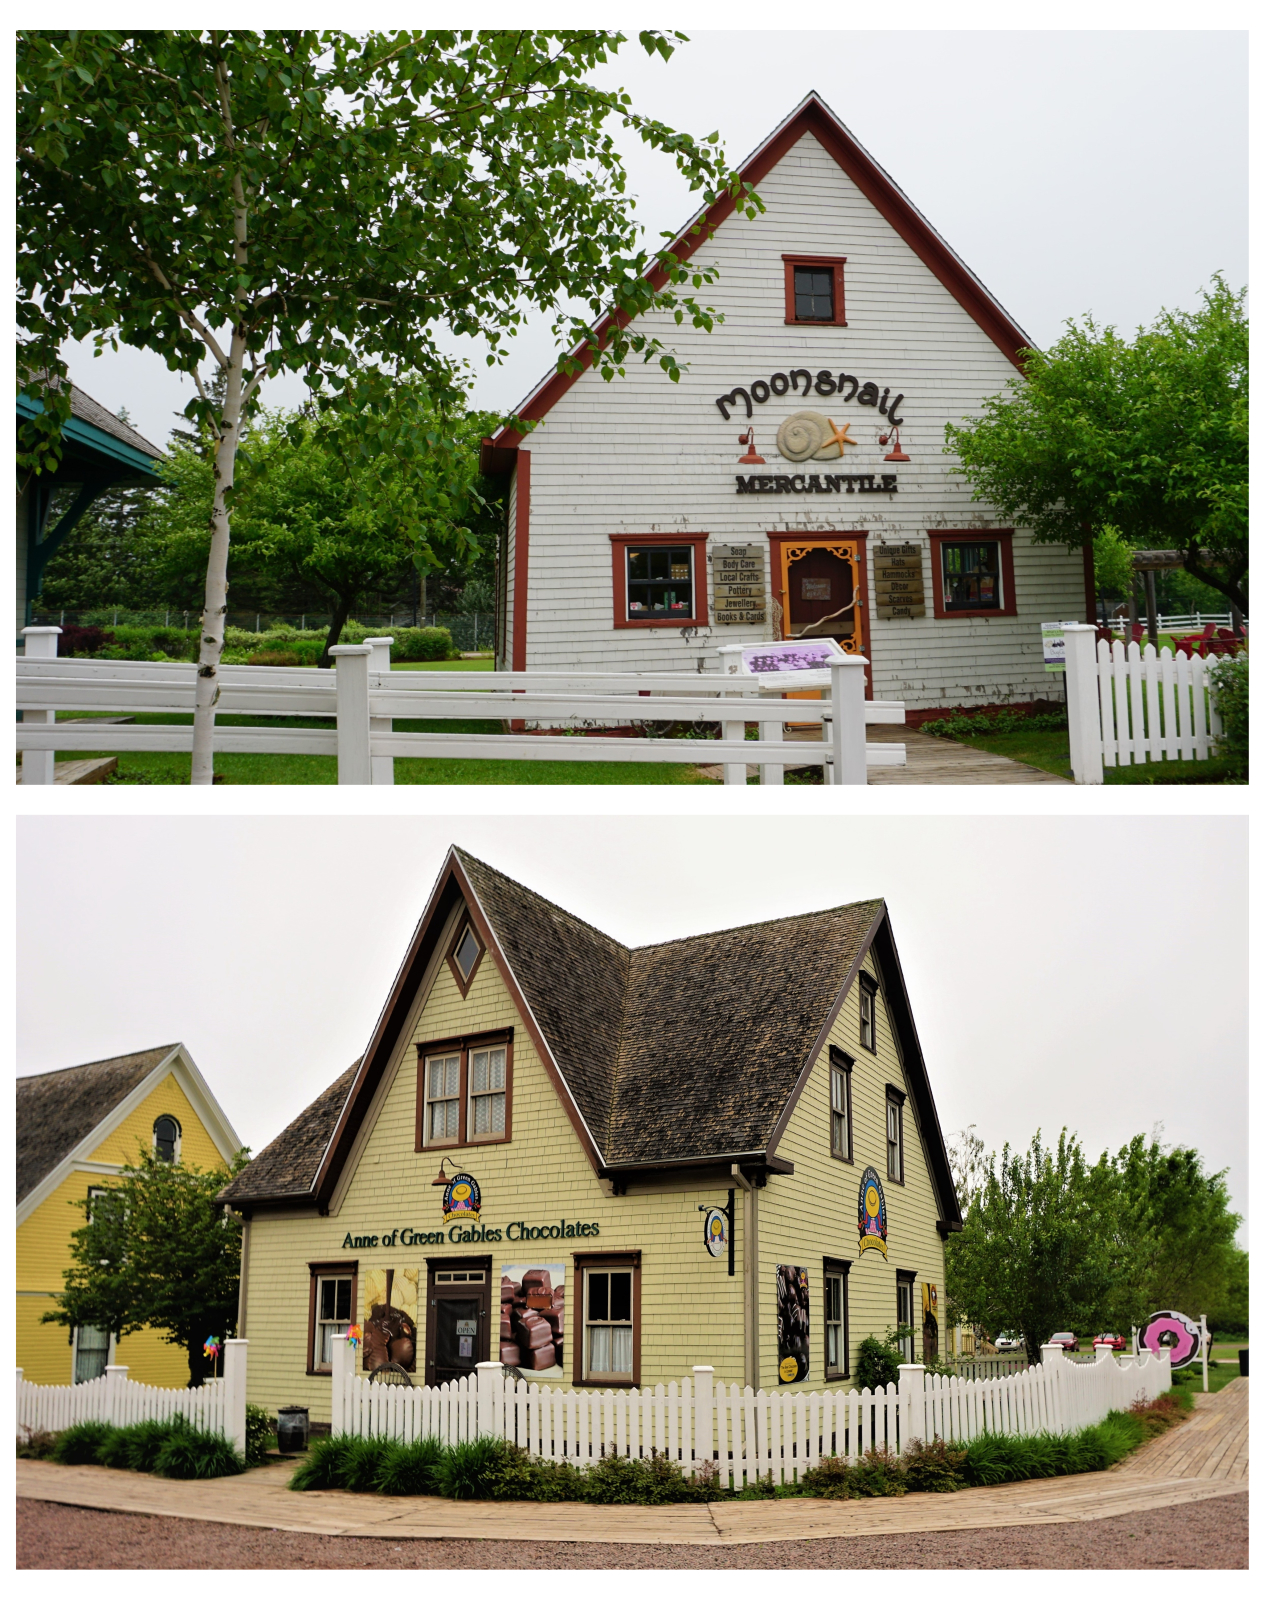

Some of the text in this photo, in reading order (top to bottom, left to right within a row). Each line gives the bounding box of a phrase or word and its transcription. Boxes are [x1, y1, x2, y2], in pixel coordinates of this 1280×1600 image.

[736, 474, 898, 494] MERCANTILE
[730, 547, 746, 558] Soap
[880, 545, 916, 556] Unique Gifts
[723, 560, 755, 570] Body Care
[892, 558, 905, 566] Hats
[720, 572, 758, 581] Local Crafts
[882, 570, 915, 578] Hammocks
[728, 586, 752, 596] Pottery
[725, 599, 756, 608] Jewellery
[889, 595, 912, 604] Scarves
[892, 607, 911, 616] Candy
[718, 612, 764, 622] Books & Cards
[342, 1219, 600, 1249] Anne of Green Gables Chocolates
[864, 1238, 884, 1250] Chocolates
